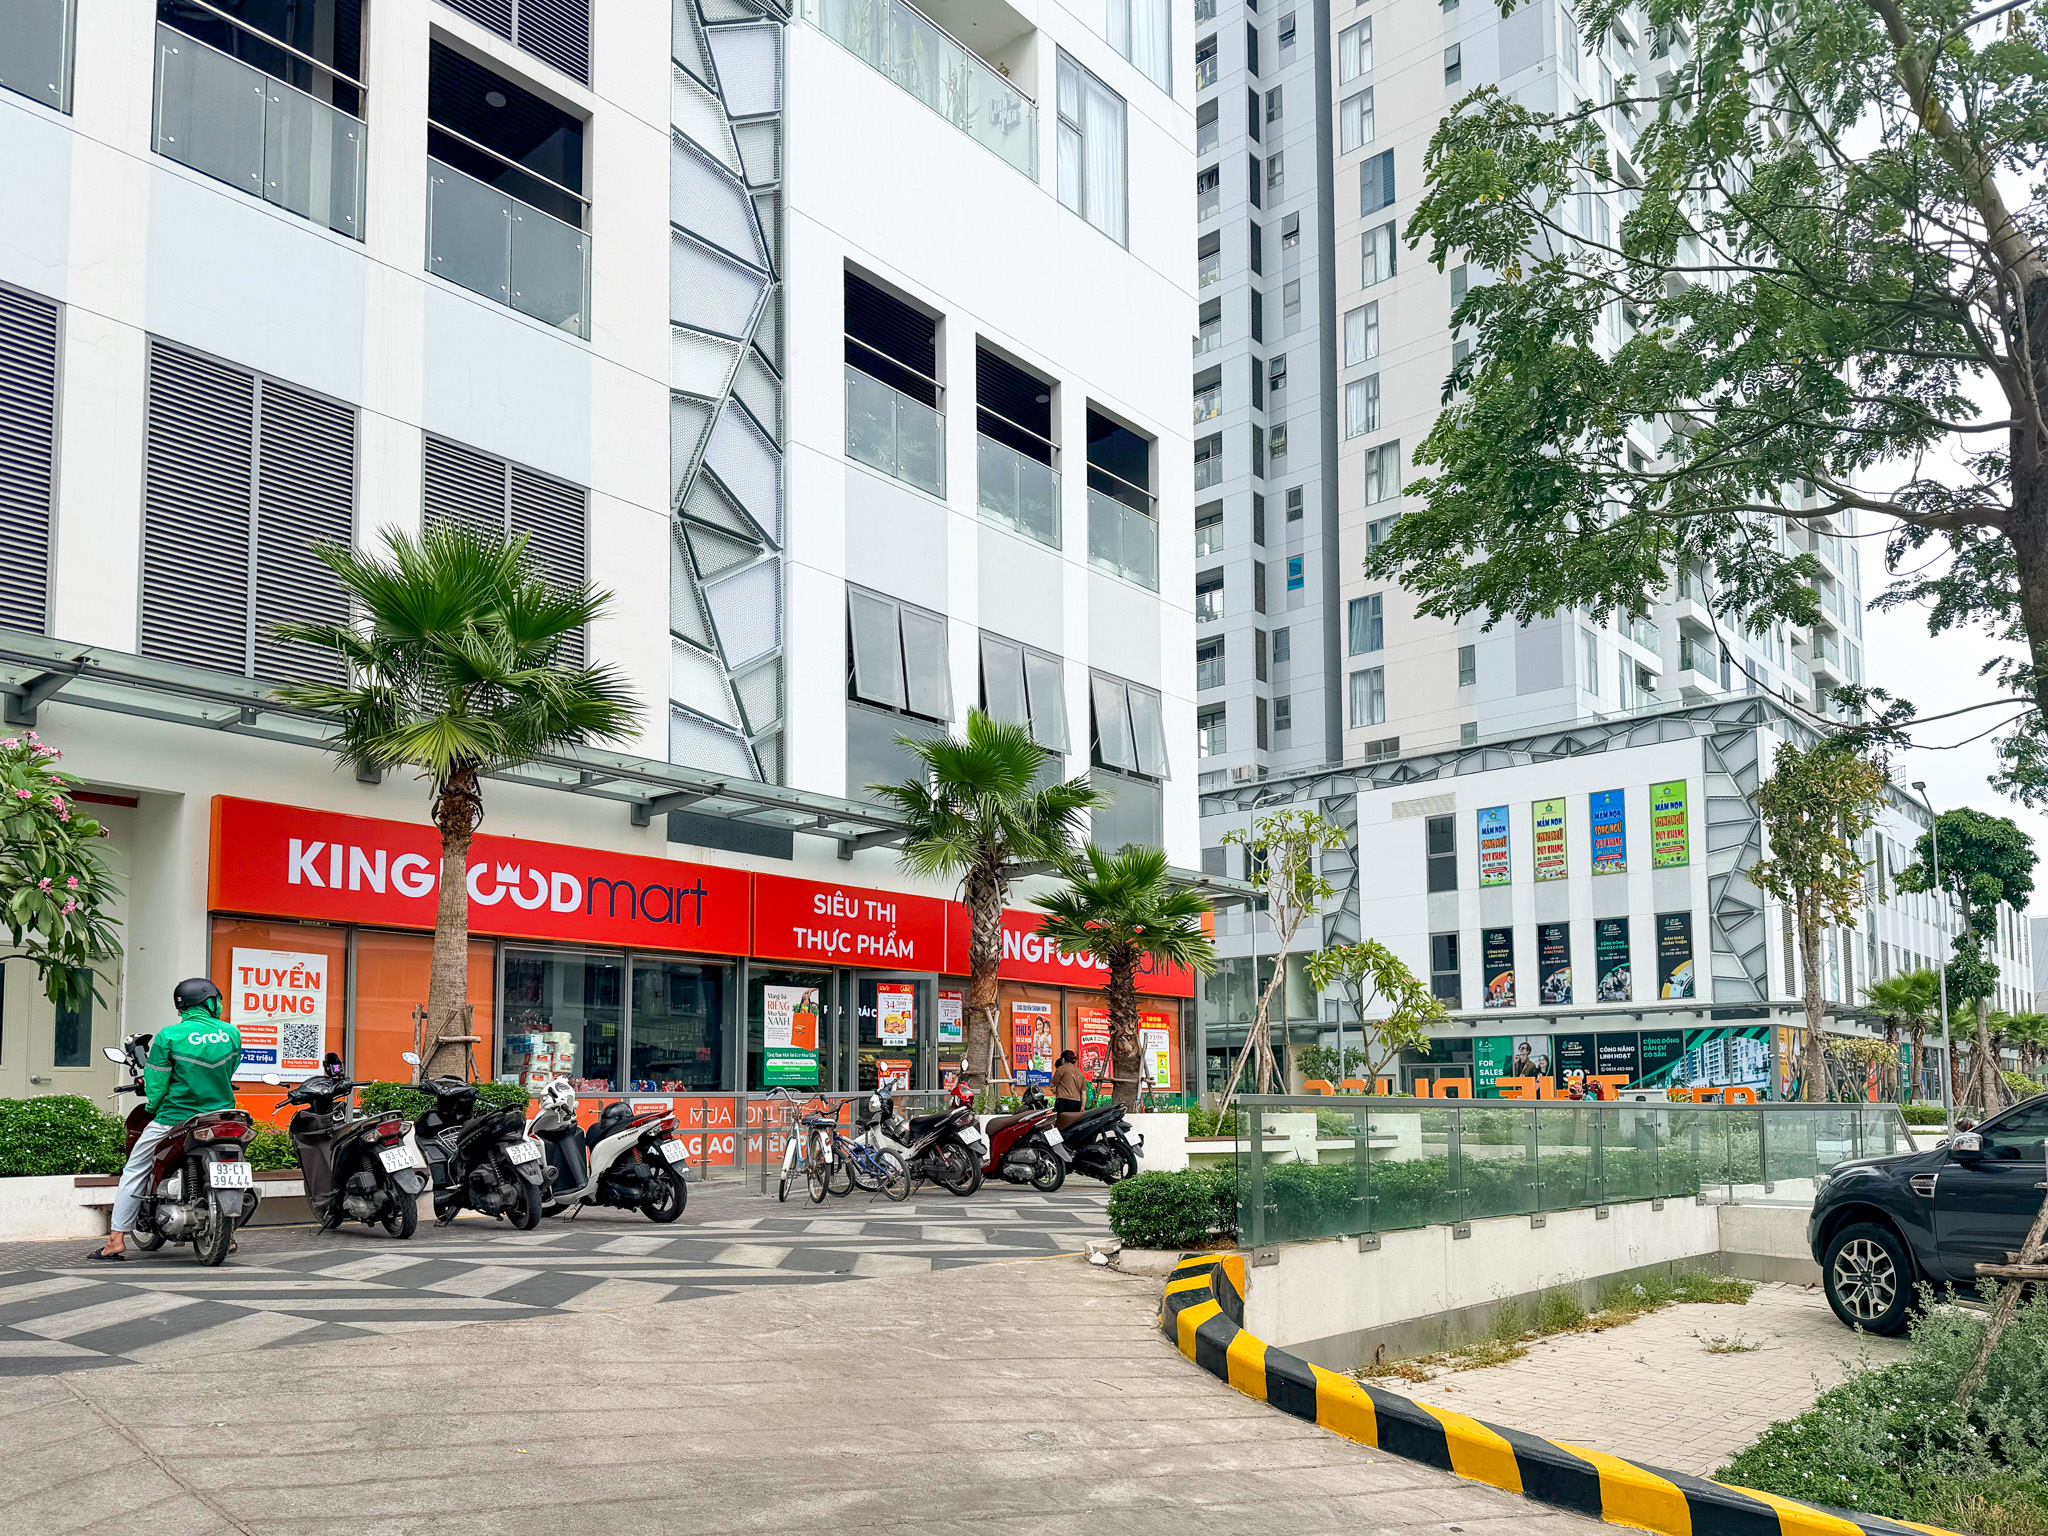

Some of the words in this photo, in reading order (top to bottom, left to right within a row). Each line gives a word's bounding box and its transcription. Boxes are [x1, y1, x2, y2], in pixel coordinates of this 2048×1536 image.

[813, 890, 859, 919] SIÊU
[865, 900, 897, 929] THỊ
[792, 926, 851, 957] THỰC
[857, 928, 915, 960] PHẨM
[238, 961, 321, 990] TUYỂN
[243, 992, 315, 1018] DỤNG
[768, 999, 790, 1010] RIÊNG
[768, 1016, 790, 1026] XANH
[188, 1029, 230, 1045] Grab
[690, 1106, 732, 1124] MUA
[689, 1136, 734, 1154] GAO
[385, 1148, 408, 1161] 93-C1
[216, 1164, 244, 1174] 93-C1
[214, 1174, 250, 1186] 394.44
